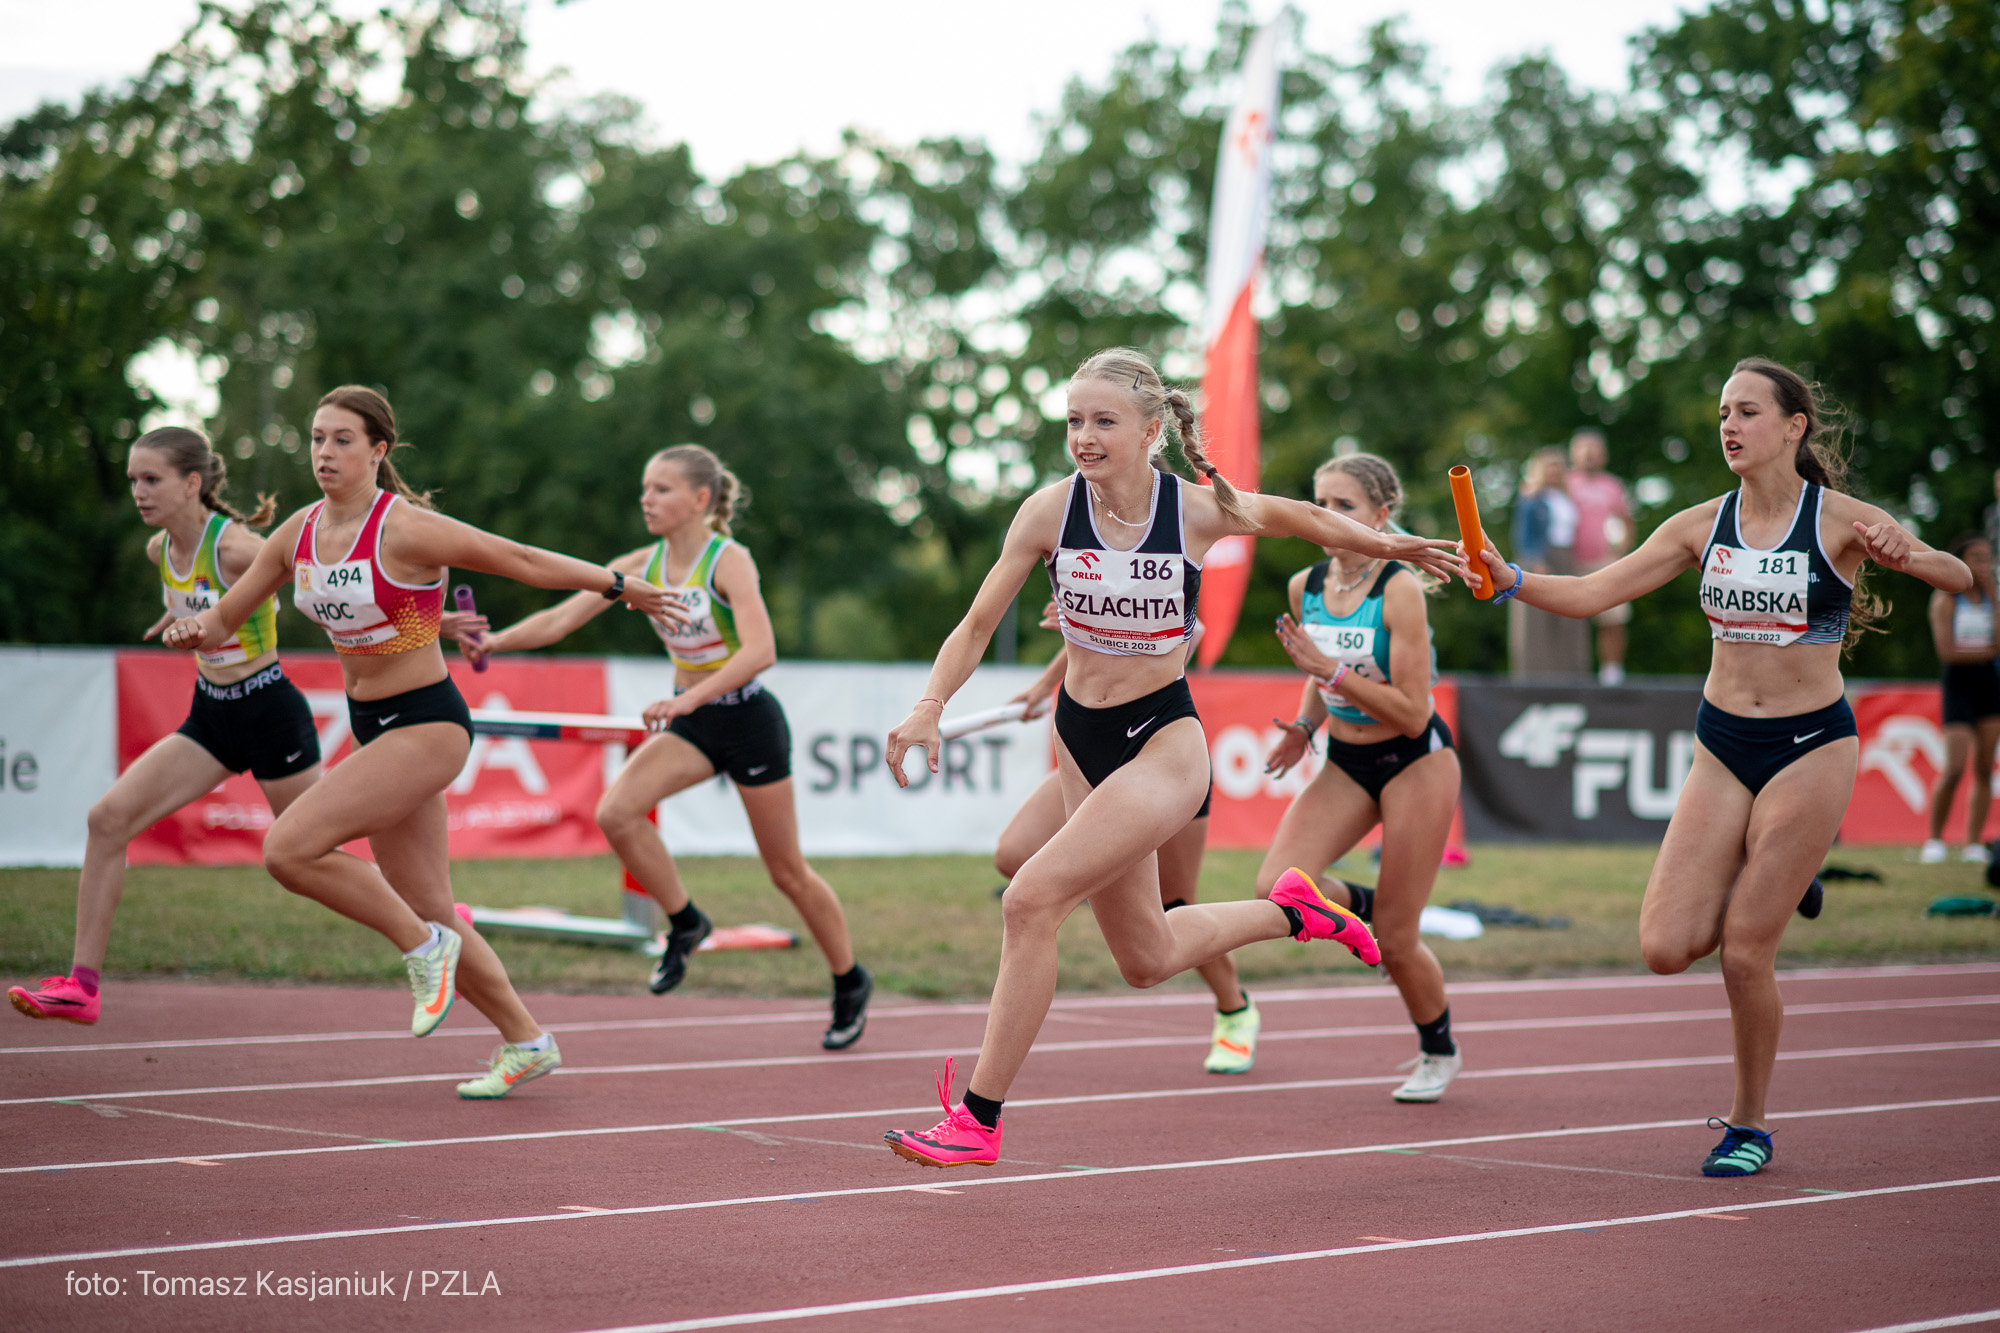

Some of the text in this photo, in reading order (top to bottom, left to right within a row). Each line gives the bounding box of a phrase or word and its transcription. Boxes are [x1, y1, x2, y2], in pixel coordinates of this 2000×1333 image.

[1129, 559, 1173, 580] 186
[1758, 557, 1797, 575] 181
[327, 567, 362, 587] 494
[1071, 571, 1102, 581] ORLEN
[186, 596, 211, 611] 464
[673, 591, 702, 607] 65
[1063, 590, 1179, 620] SZLACHTA
[1702, 583, 1803, 613] HRABSKA
[313, 602, 355, 620] HOC
[1089, 635, 1157, 650] SŁUBICE 2023
[1336, 632, 1364, 649] 450
[1758, 633, 1781, 641] 2023
[208, 682, 243, 700] NIKE
[244, 664, 282, 695] PRO
[1499, 702, 1587, 768] 4F
[810, 735, 1012, 793] SPORT
